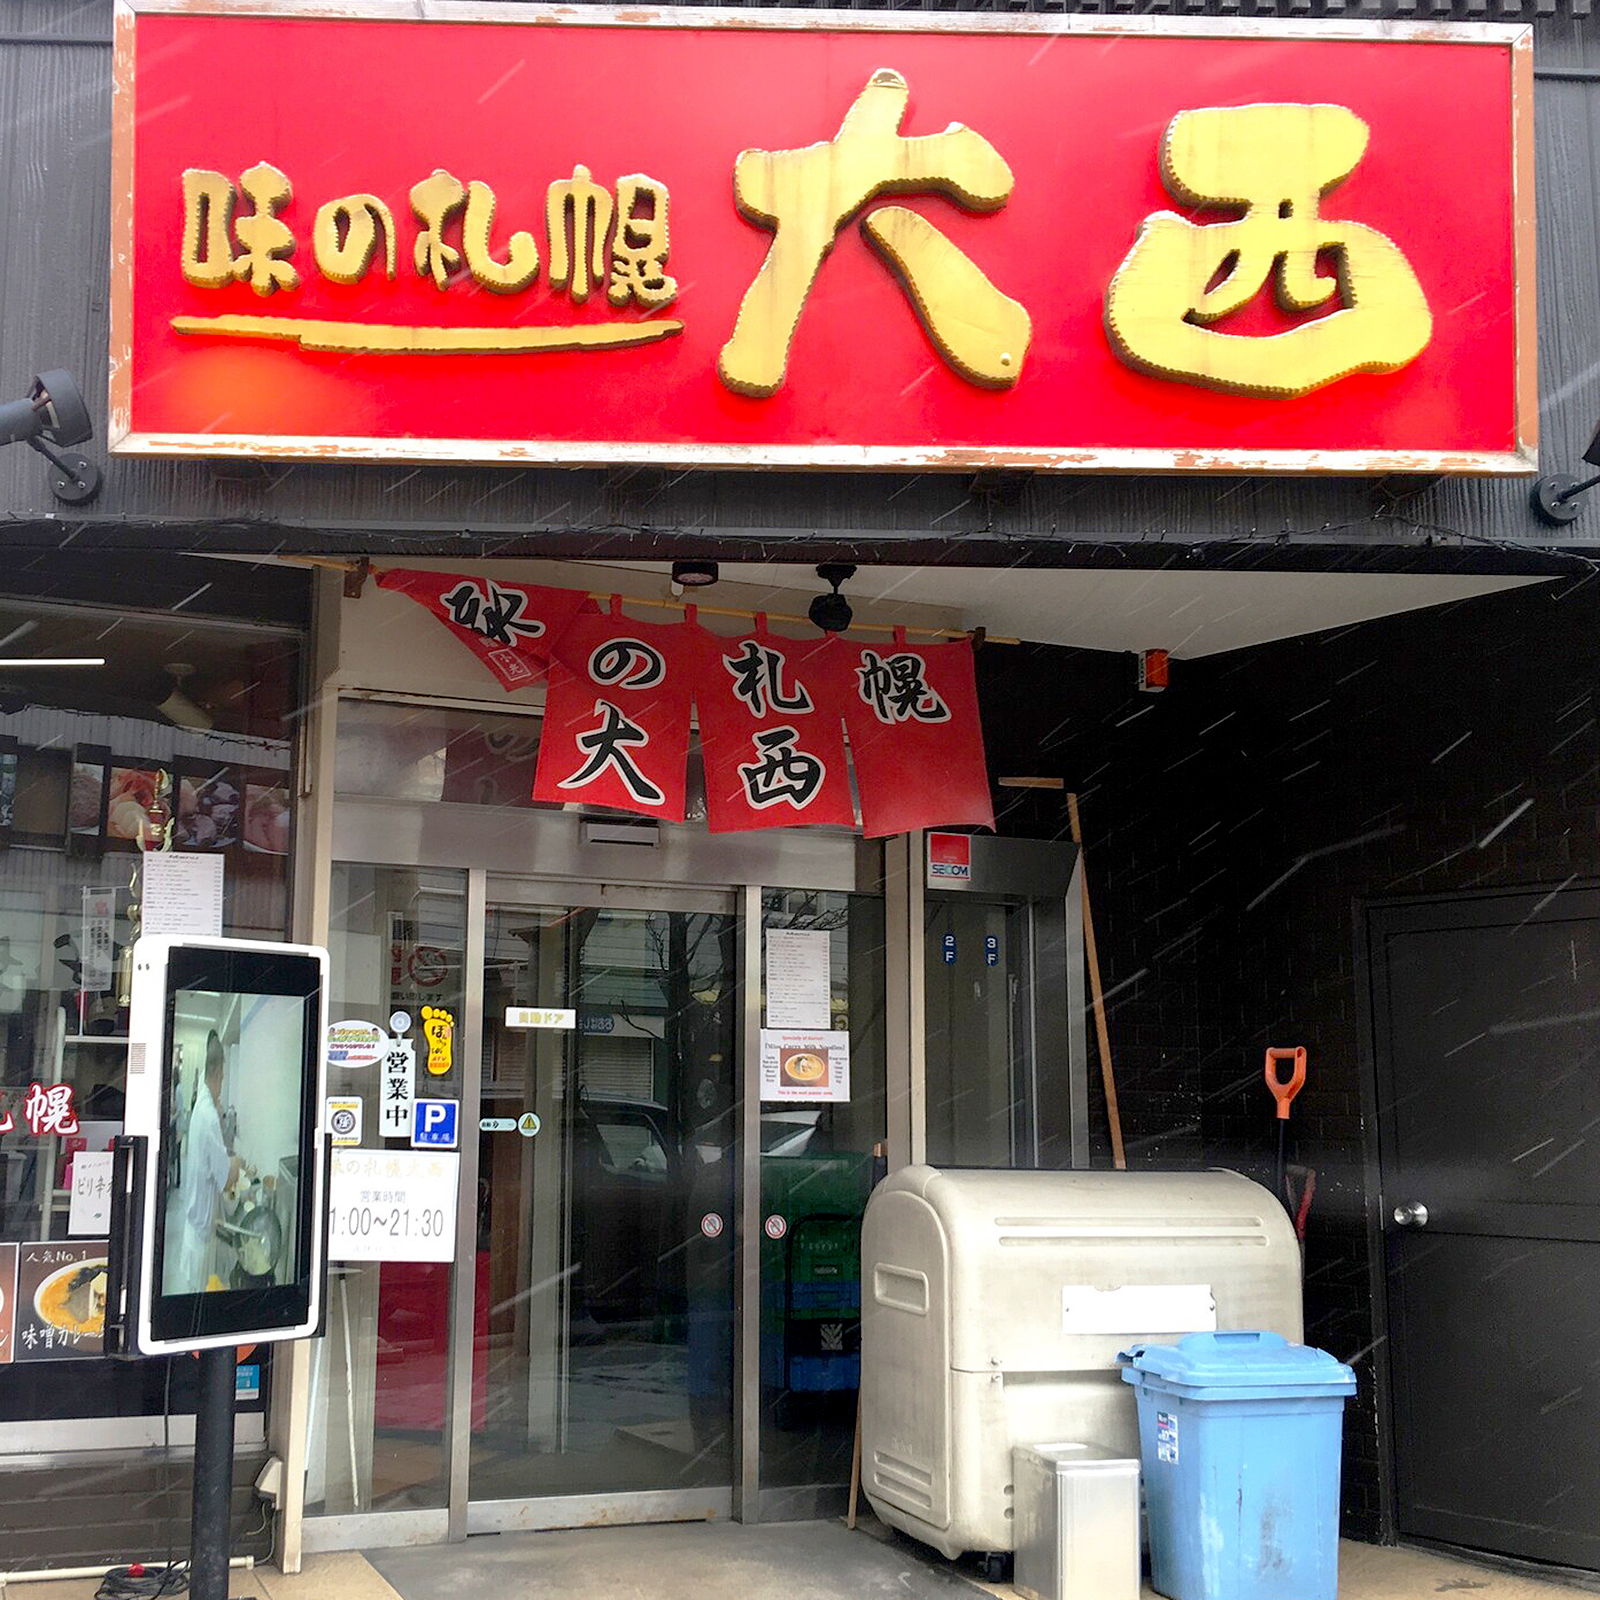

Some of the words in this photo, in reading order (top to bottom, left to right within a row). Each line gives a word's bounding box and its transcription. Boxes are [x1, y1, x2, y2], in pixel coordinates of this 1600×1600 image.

[181, 161, 678, 308] 味の札幌
[717, 68, 1433, 398] 大西
[931, 864, 968, 876] SECOM
[386, 1051, 409, 1127] 営業中
[0, 1084, 80, 1136] 幌
[424, 1104, 446, 1132] P
[360, 1190, 406, 1203] 営業時間
